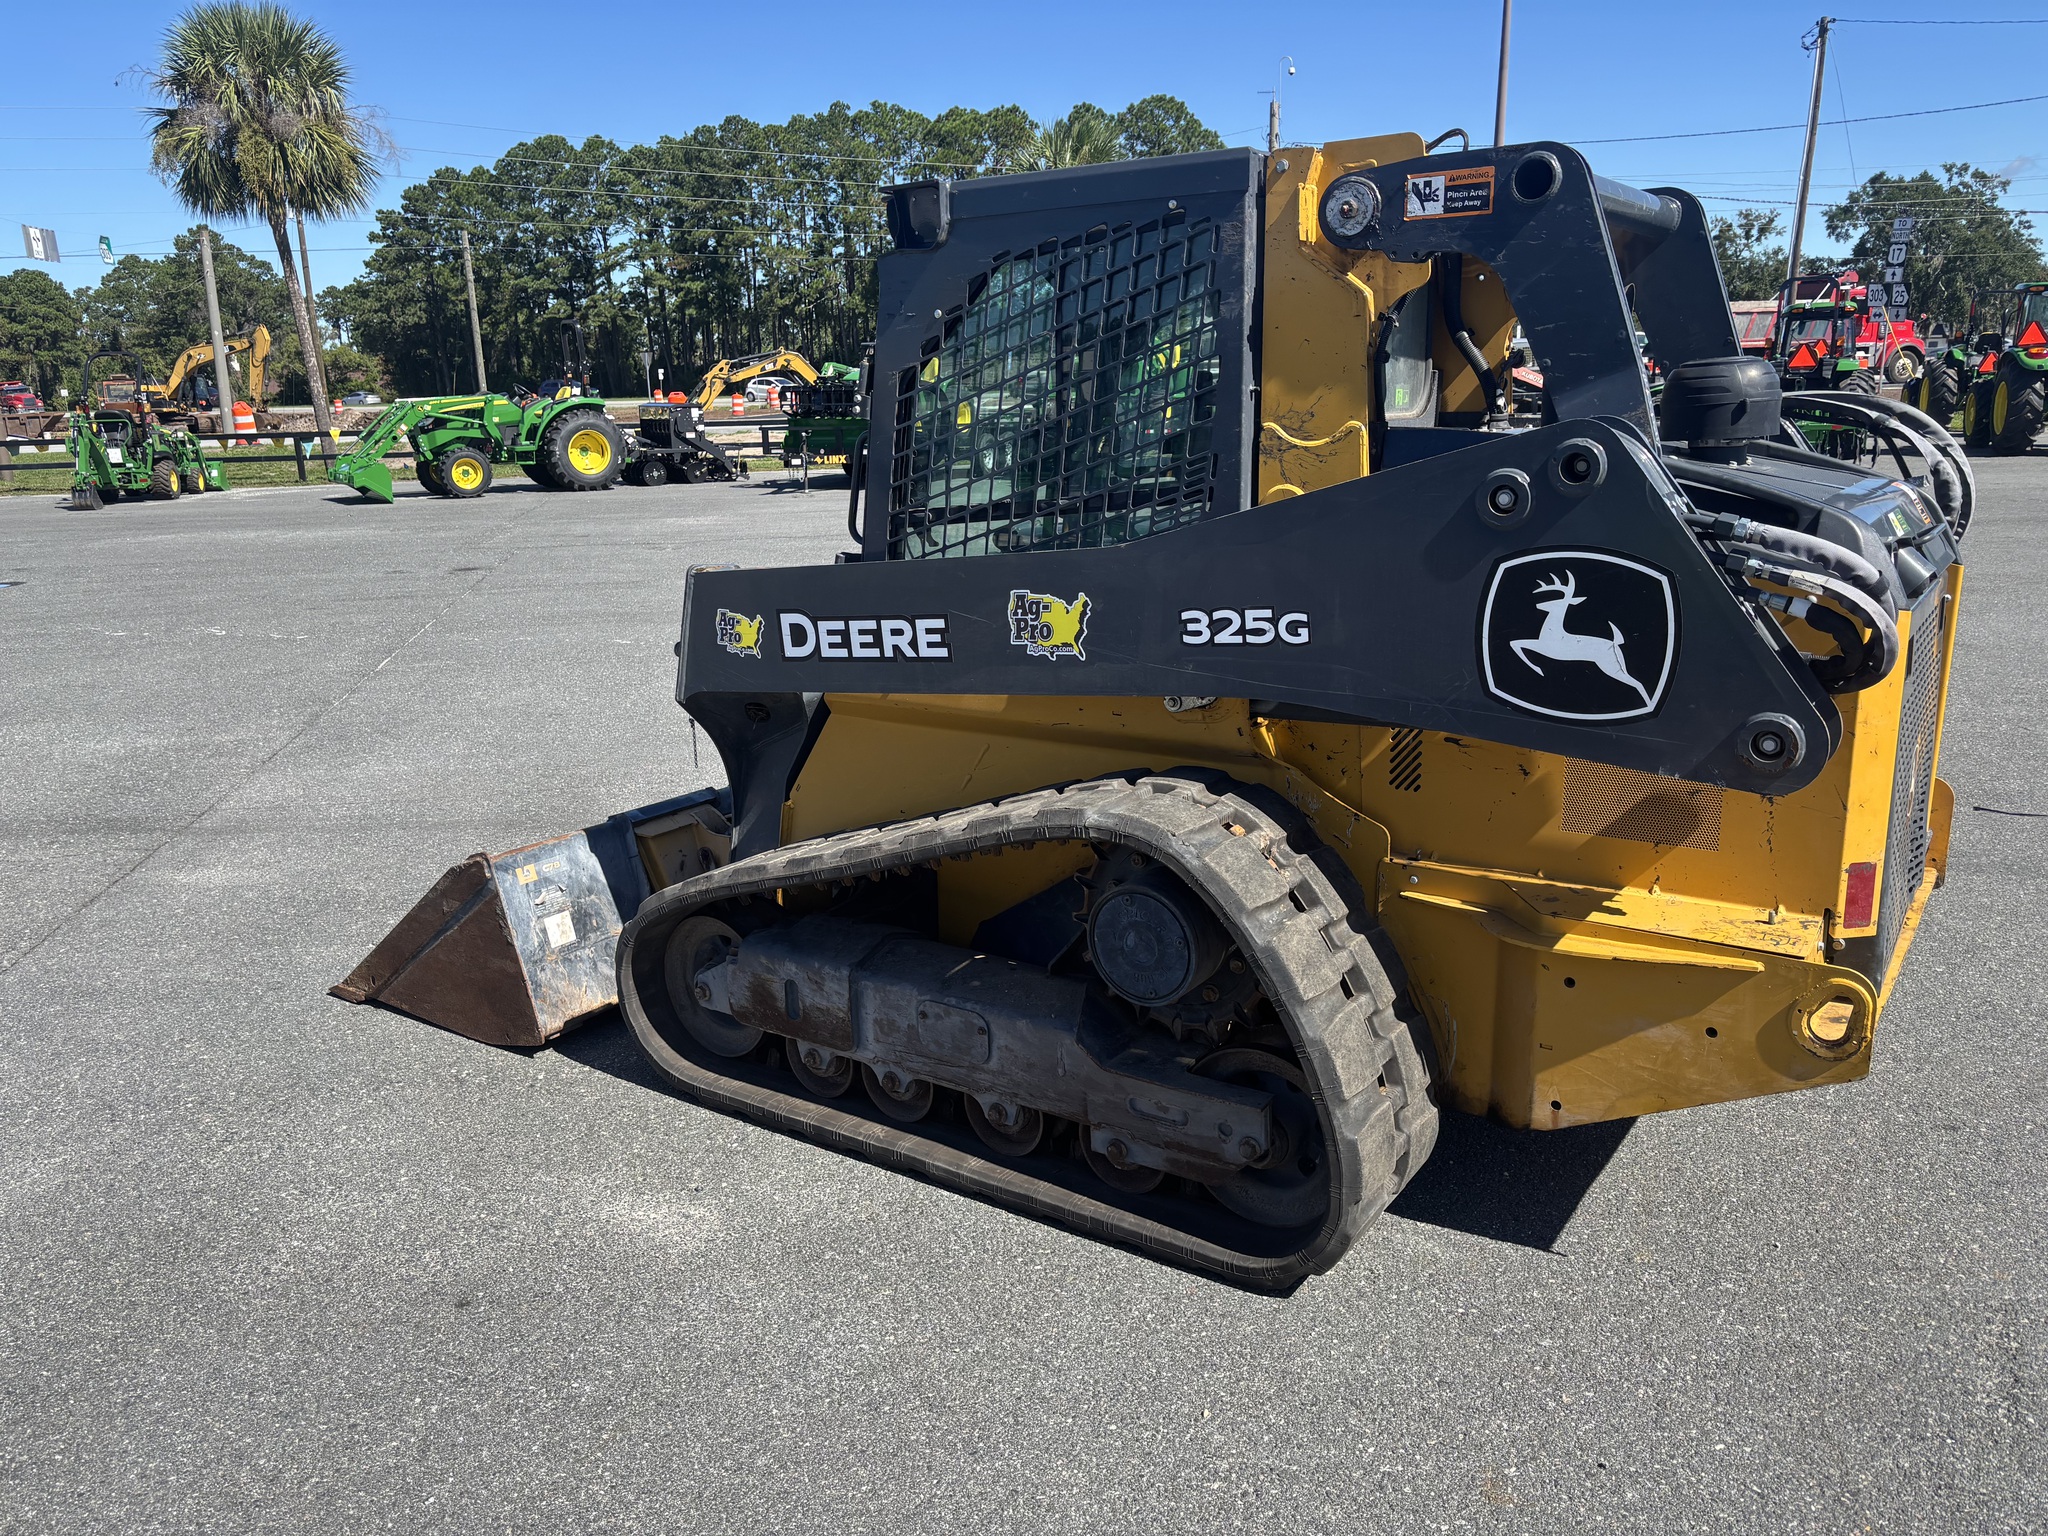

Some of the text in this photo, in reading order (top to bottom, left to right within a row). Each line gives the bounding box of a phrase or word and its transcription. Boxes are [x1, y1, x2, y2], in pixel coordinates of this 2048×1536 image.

[1455, 171, 1490, 181] WARNING
[1447, 188, 1489, 199] Pinch Area
[1463, 199, 1482, 208] Away
[1898, 219, 1908, 228] TO
[1892, 231, 1909, 240] NORTH
[100, 247, 112, 260] 303
[1891, 247, 1904, 261] 17
[1869, 289, 1884, 302] 303
[1893, 290, 1906, 304] 25
[824, 454, 847, 464] LINX
[1014, 618, 1053, 641] Pro
[1181, 609, 1310, 644] 325G
[719, 627, 742, 643] Pro
[779, 613, 949, 658] DEERE
[1029, 645, 1074, 653] AgProCo.com
[542, 861, 561, 872] C78
